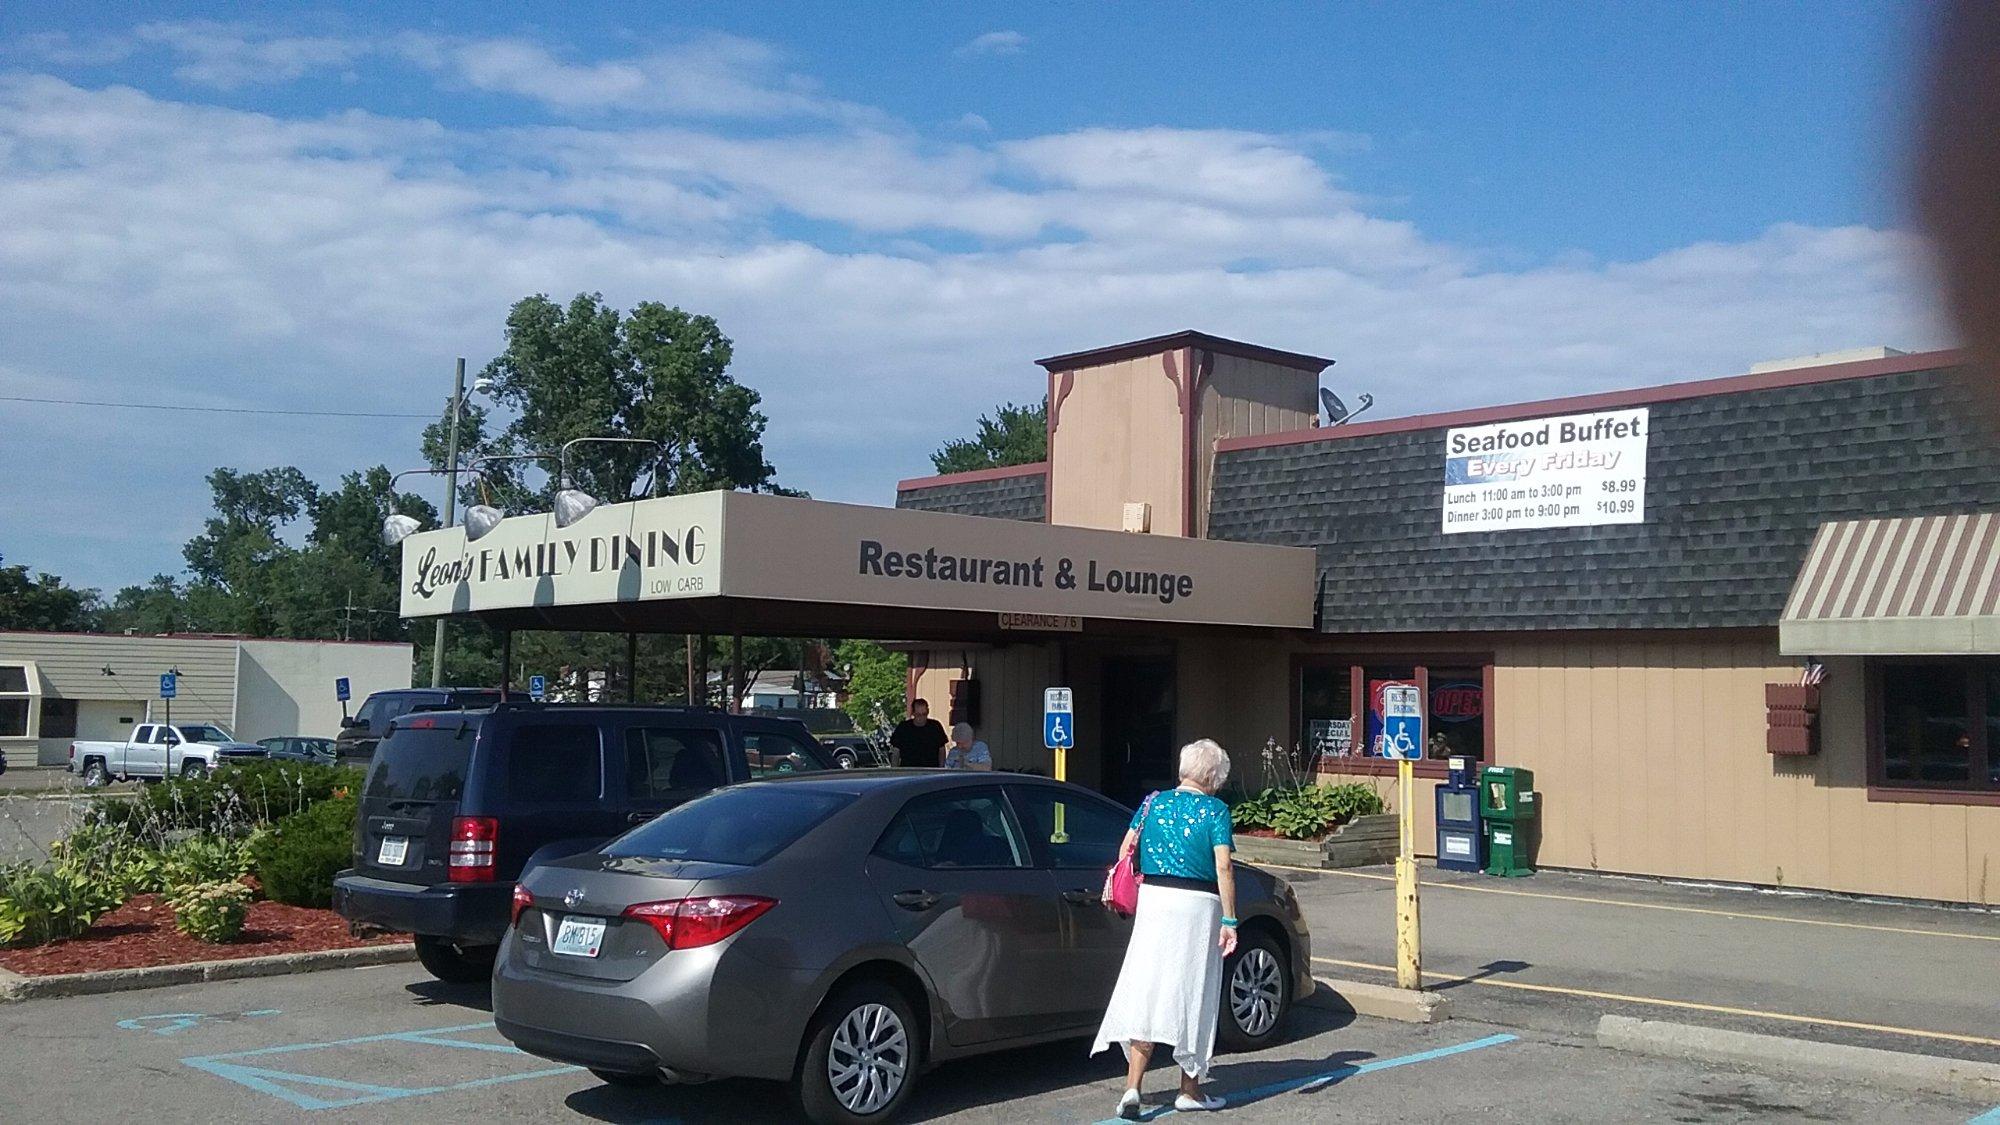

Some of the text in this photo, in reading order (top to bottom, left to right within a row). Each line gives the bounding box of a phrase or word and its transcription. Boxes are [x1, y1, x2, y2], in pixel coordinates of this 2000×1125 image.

[1451, 416, 1640, 454] Seafood Buffet
[1466, 450, 1621, 480] Every Friday
[1448, 479, 1636, 505] Lunch 11:00 am to 3:00 pm $8.99
[1448, 500, 1634, 523] Dinner 3:00 pm to 9:00 pm $10.99
[411, 525, 706, 599] Leon's FAMILY DINING
[858, 540, 1194, 604] Restaurant & Lounge
[651, 576, 704, 594] LOW CARB
[1001, 614, 1058, 628] CLEARANCE
